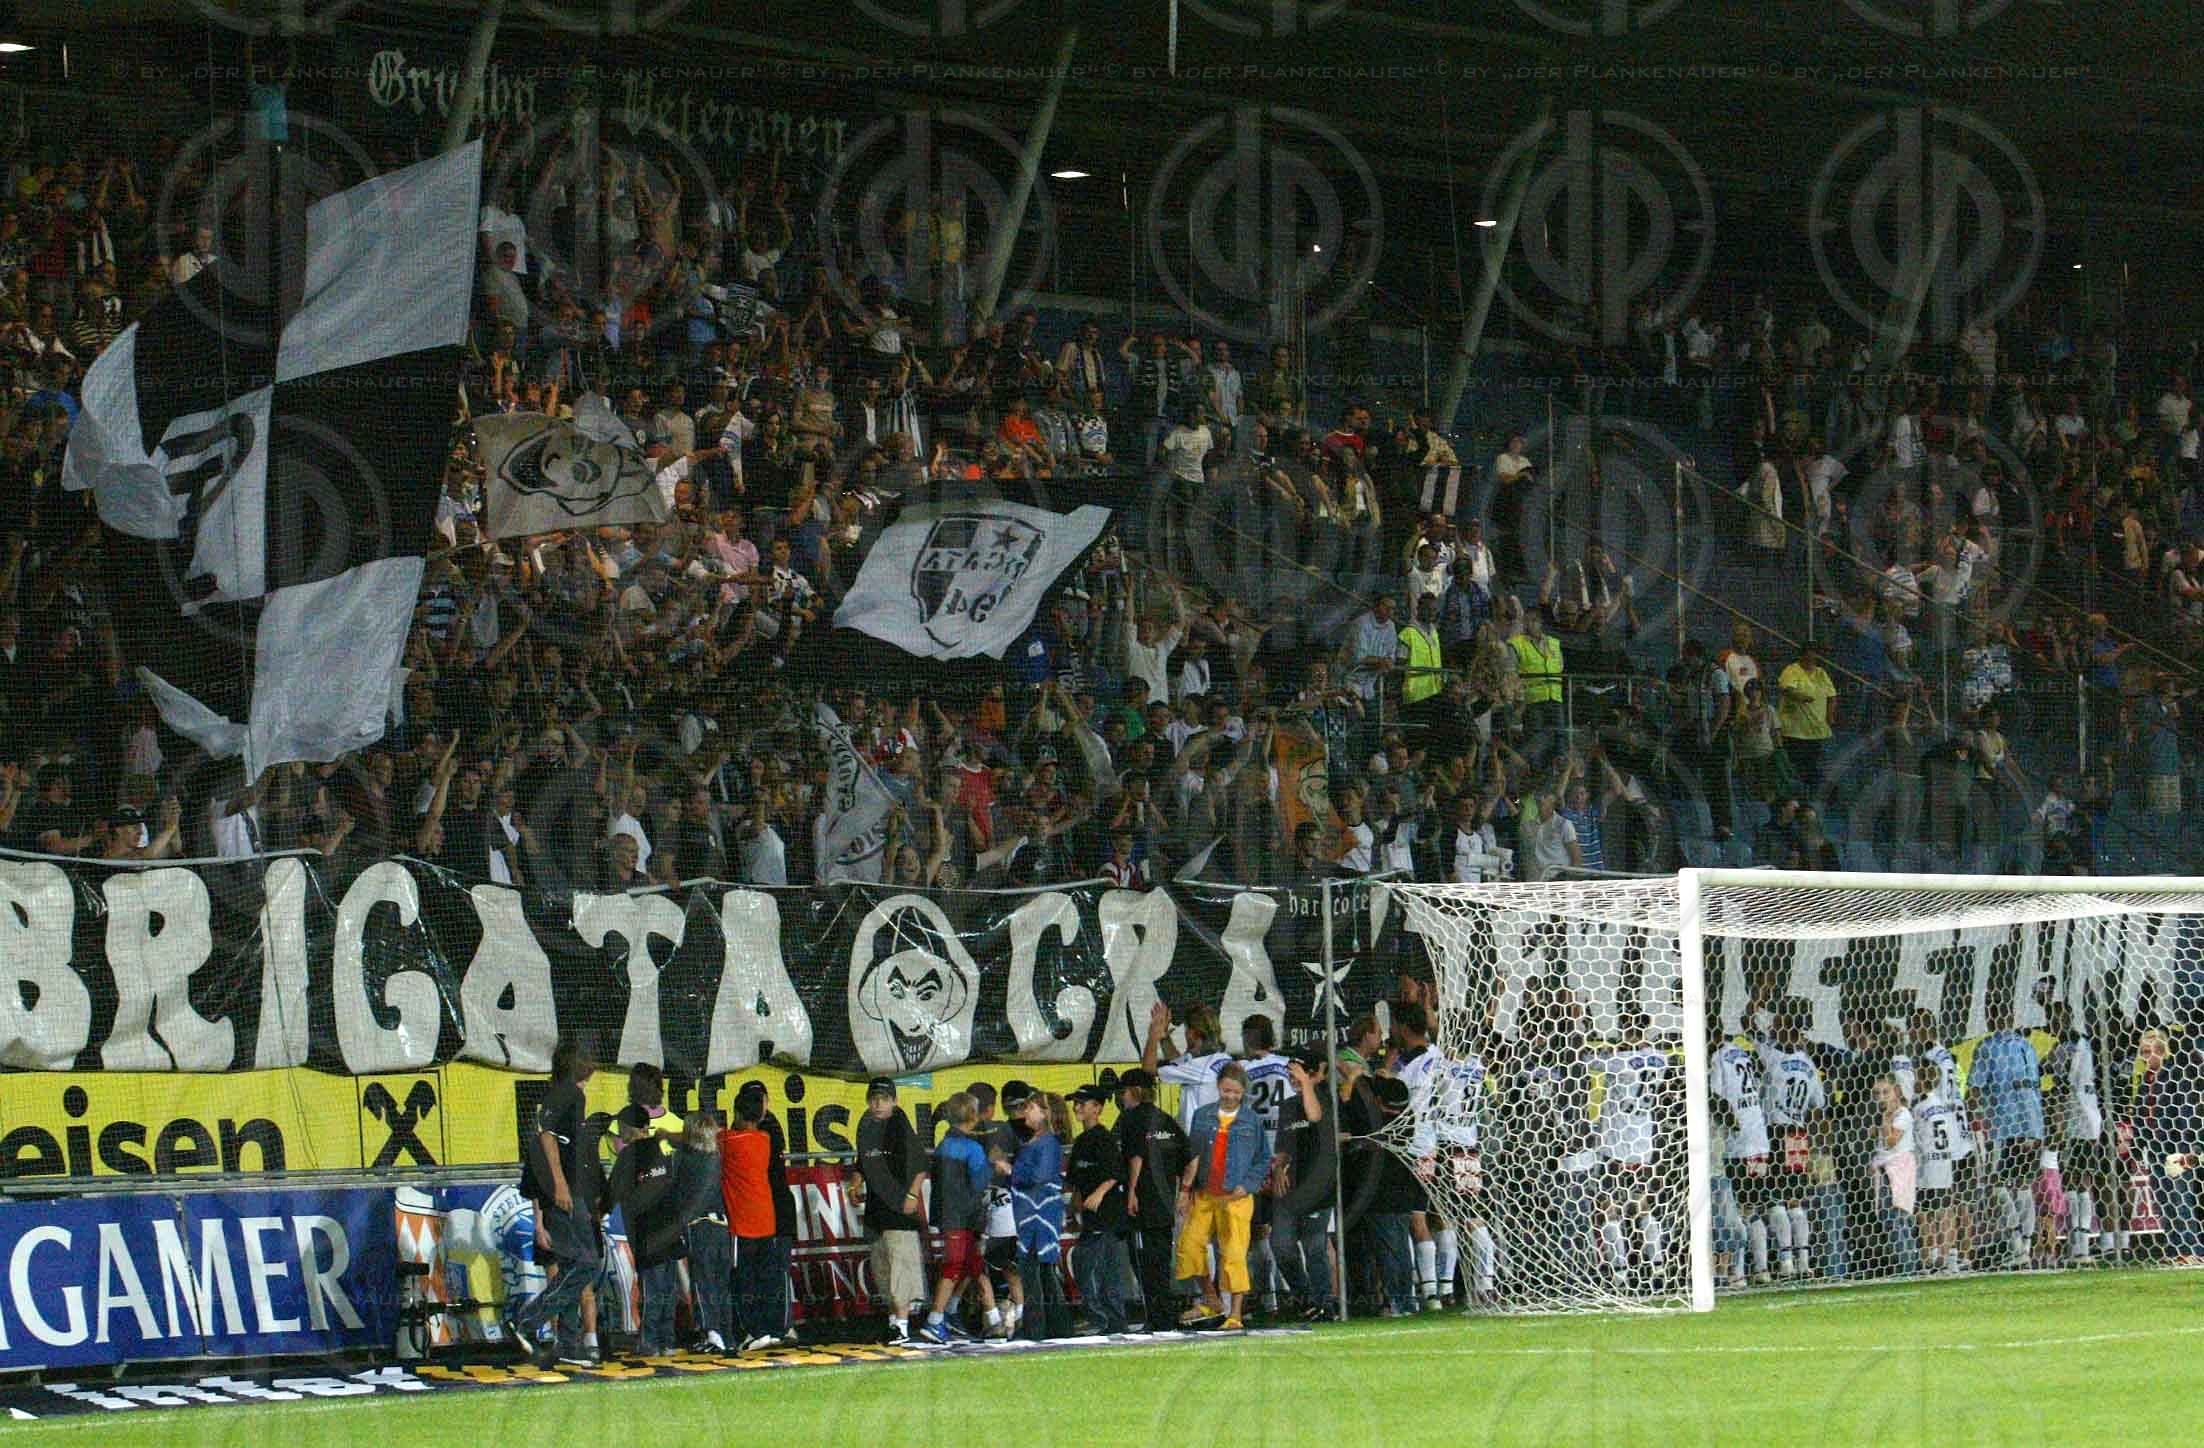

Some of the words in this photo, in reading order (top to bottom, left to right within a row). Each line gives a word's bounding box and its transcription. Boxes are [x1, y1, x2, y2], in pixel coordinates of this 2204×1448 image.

[1288, 889, 1369, 917] harcore
[0, 856, 812, 1073] BRIGATA
[1251, 1079, 1284, 1114] 24
[1933, 1119, 1949, 1150] 5
[0, 1215, 366, 1350] GAMER
